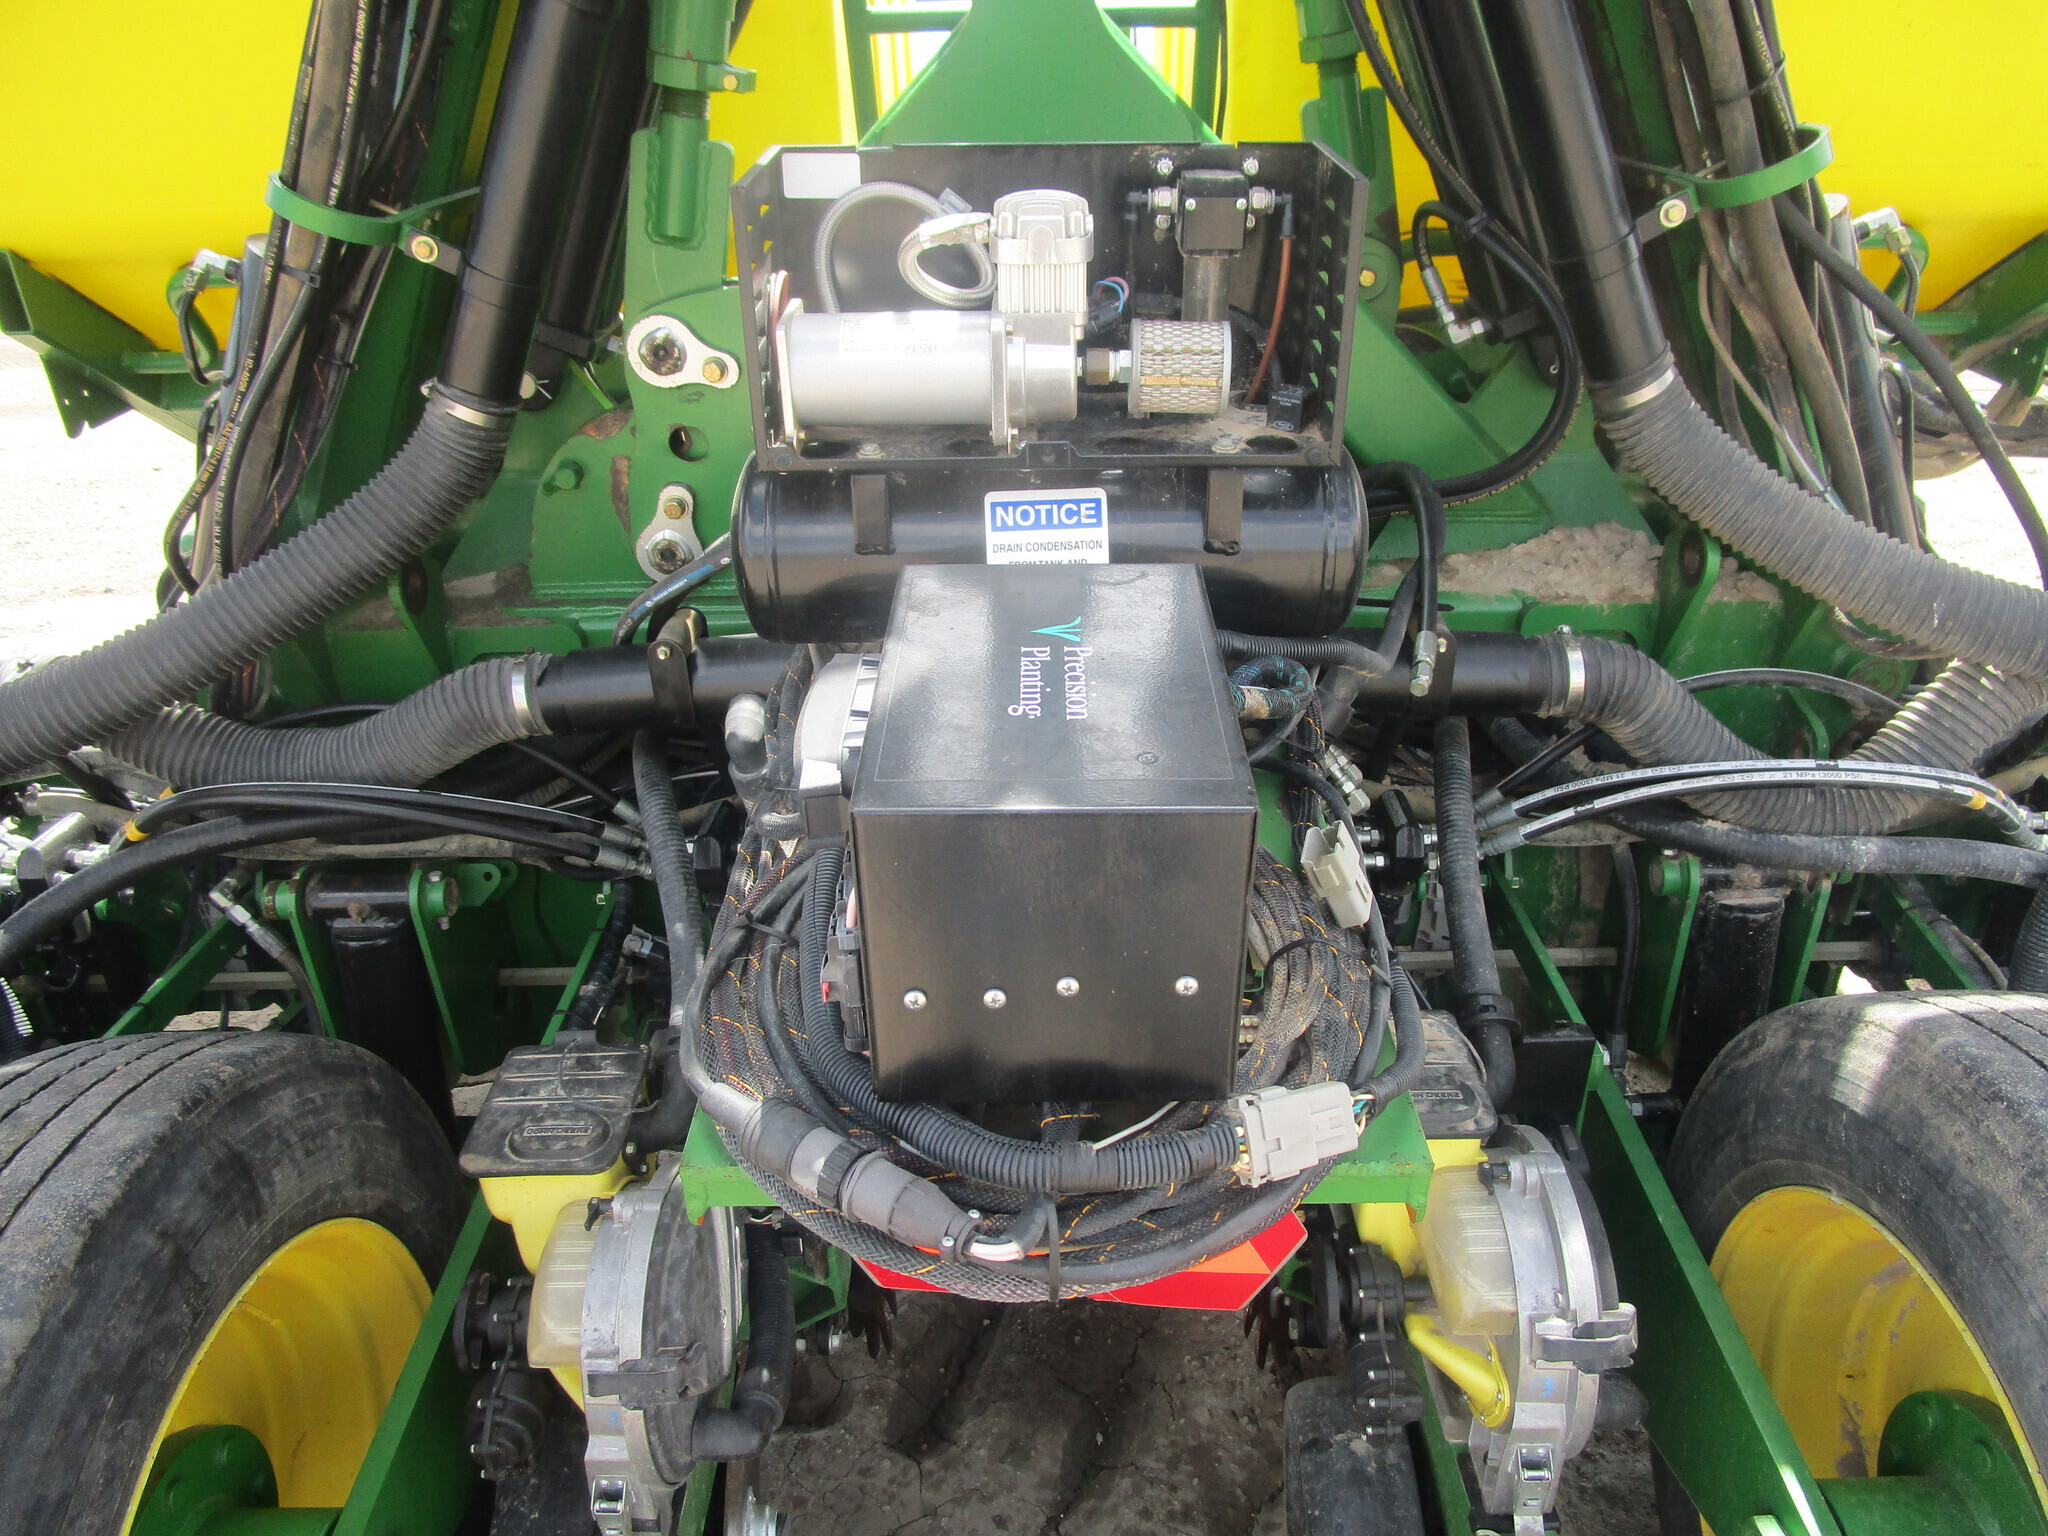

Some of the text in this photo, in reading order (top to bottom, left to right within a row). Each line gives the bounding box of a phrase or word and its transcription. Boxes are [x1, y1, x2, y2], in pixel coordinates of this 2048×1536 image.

[995, 503, 1098, 527] NOTICE
[992, 540, 1102, 553] DRAIN CONDENSATION
[1063, 646, 1096, 720] Precision
[1818, 771, 1843, 779] (3000
